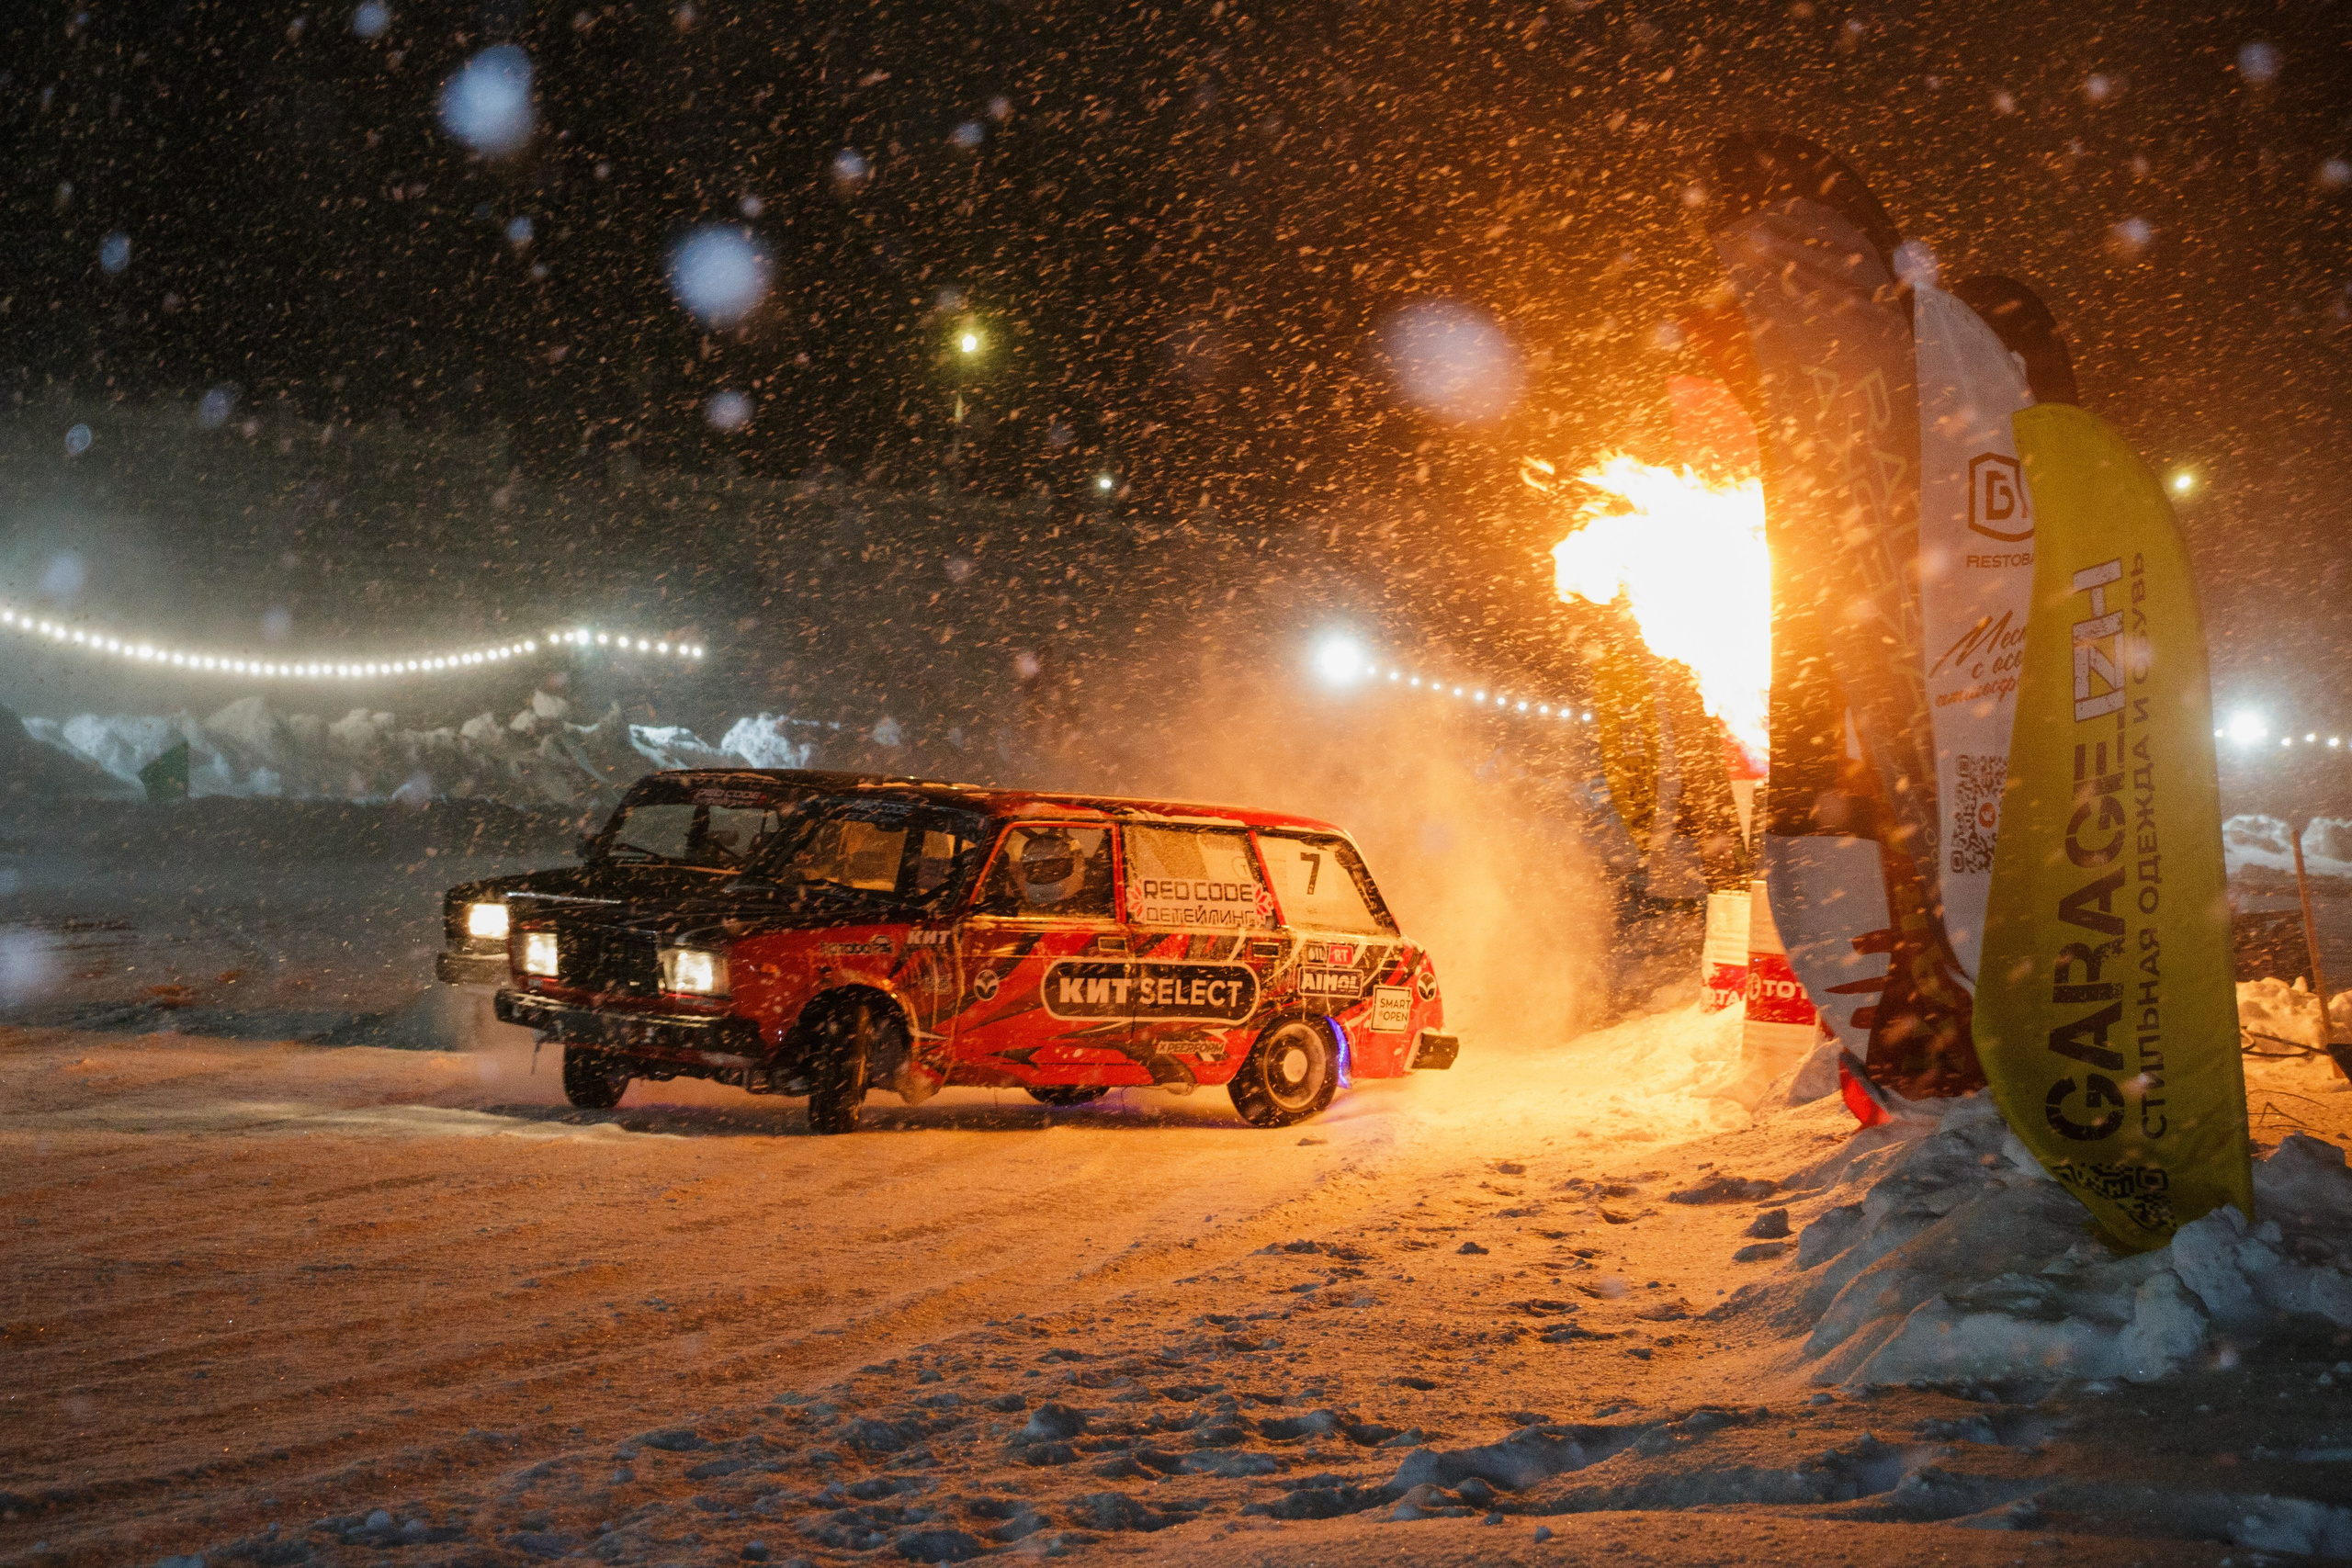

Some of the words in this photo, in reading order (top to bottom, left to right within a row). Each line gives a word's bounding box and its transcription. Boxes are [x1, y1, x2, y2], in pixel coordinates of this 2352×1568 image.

[2132, 698, 2150, 723] И
[2133, 735, 2162, 915] ОДЕЖДА
[1300, 852, 1321, 895] 7
[1144, 879, 1190, 901] RED
[1194, 882, 1253, 903] CODE
[1147, 905, 1255, 925] ДЕТЕЙЛИНГ
[907, 931, 951, 944] КИТ
[1333, 948, 1349, 962] RT
[1059, 977, 1132, 1004] КИТ
[1139, 977, 1243, 1008] SELECT
[1300, 973, 1360, 993] AIMOL
[1380, 998, 1412, 1010] SMART
[1383, 1010, 1408, 1021] OPEN
[2137, 928, 2167, 1140] СТИЛЬНАЯ
